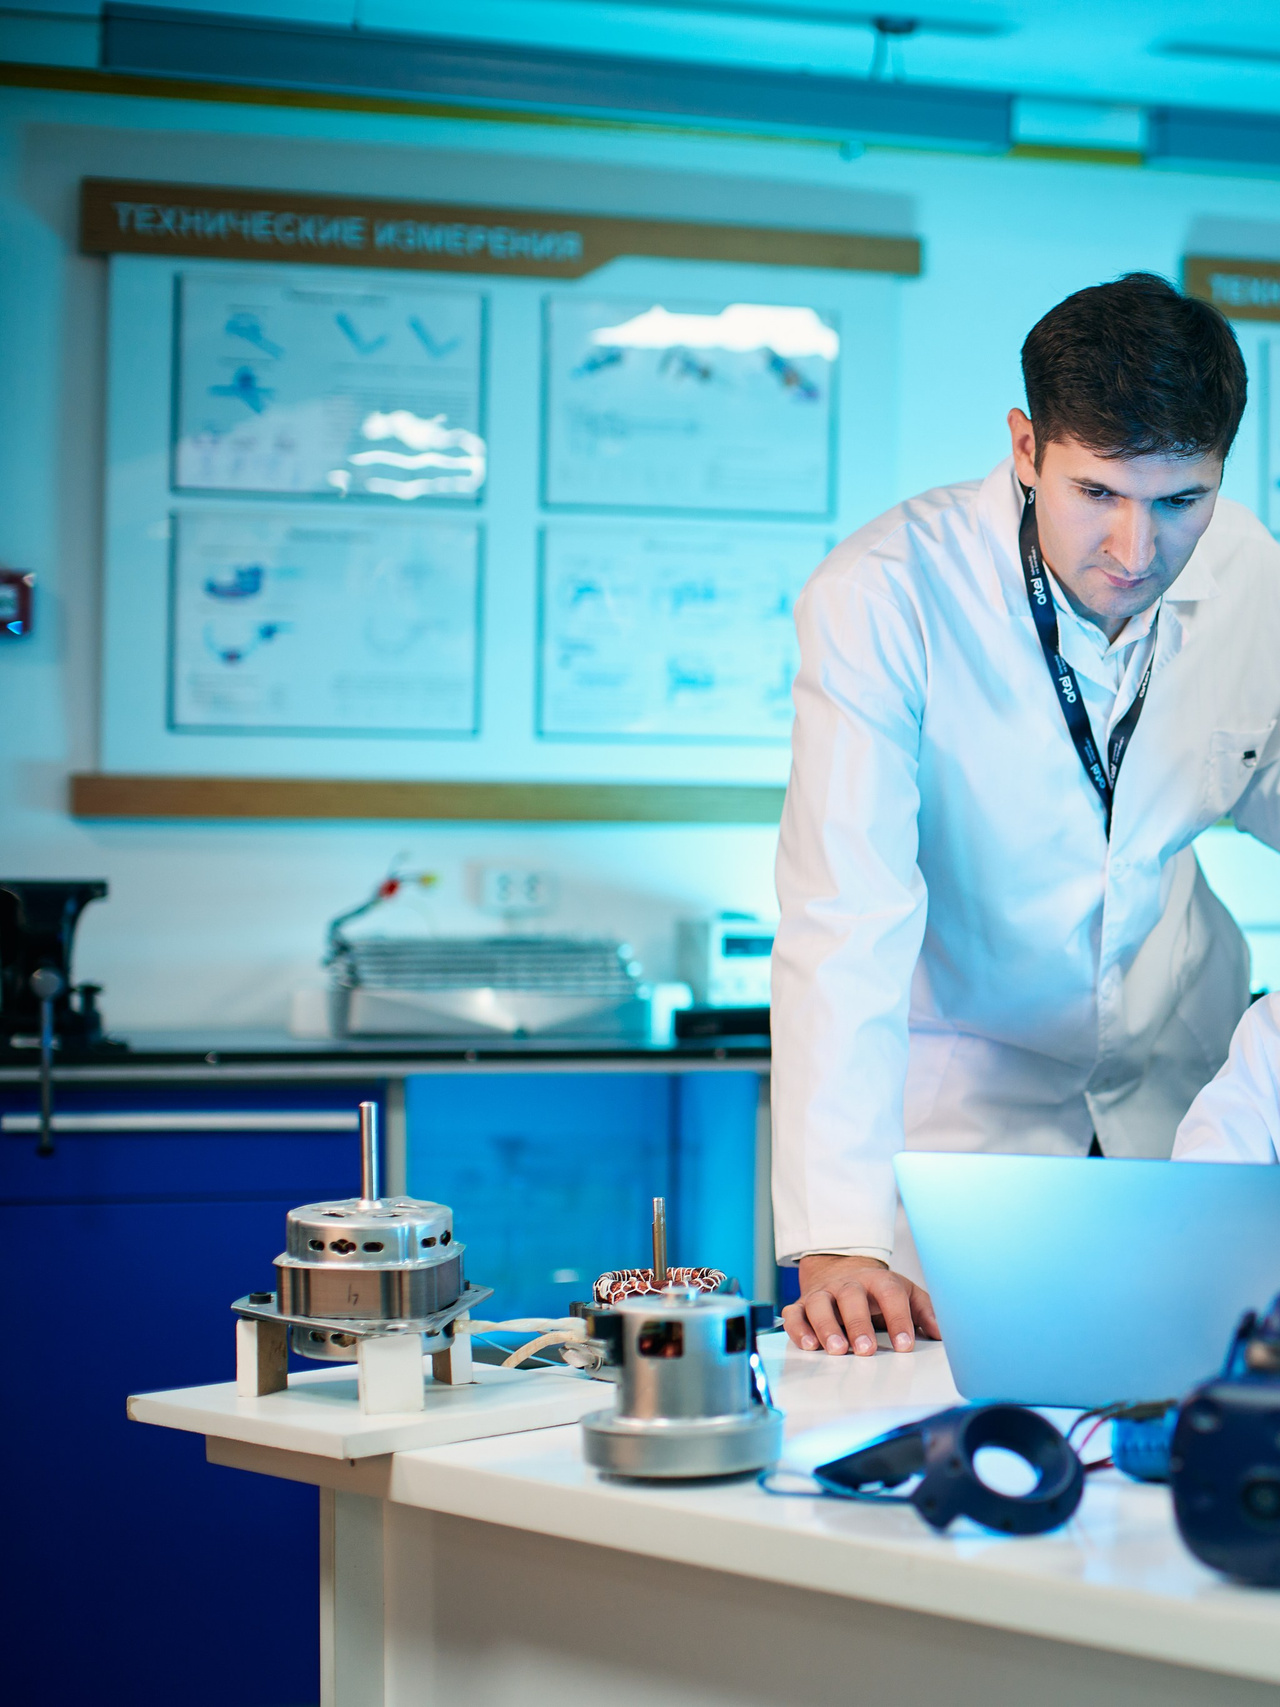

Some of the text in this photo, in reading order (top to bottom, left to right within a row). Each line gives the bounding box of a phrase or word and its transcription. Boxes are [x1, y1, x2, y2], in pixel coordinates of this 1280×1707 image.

[115, 202, 583, 263] ТЕХНИЧЕСКИЕ ИЗМЕРЕНИЯ
[1030, 577, 1047, 605] artel
[1059, 675, 1077, 703] artel
